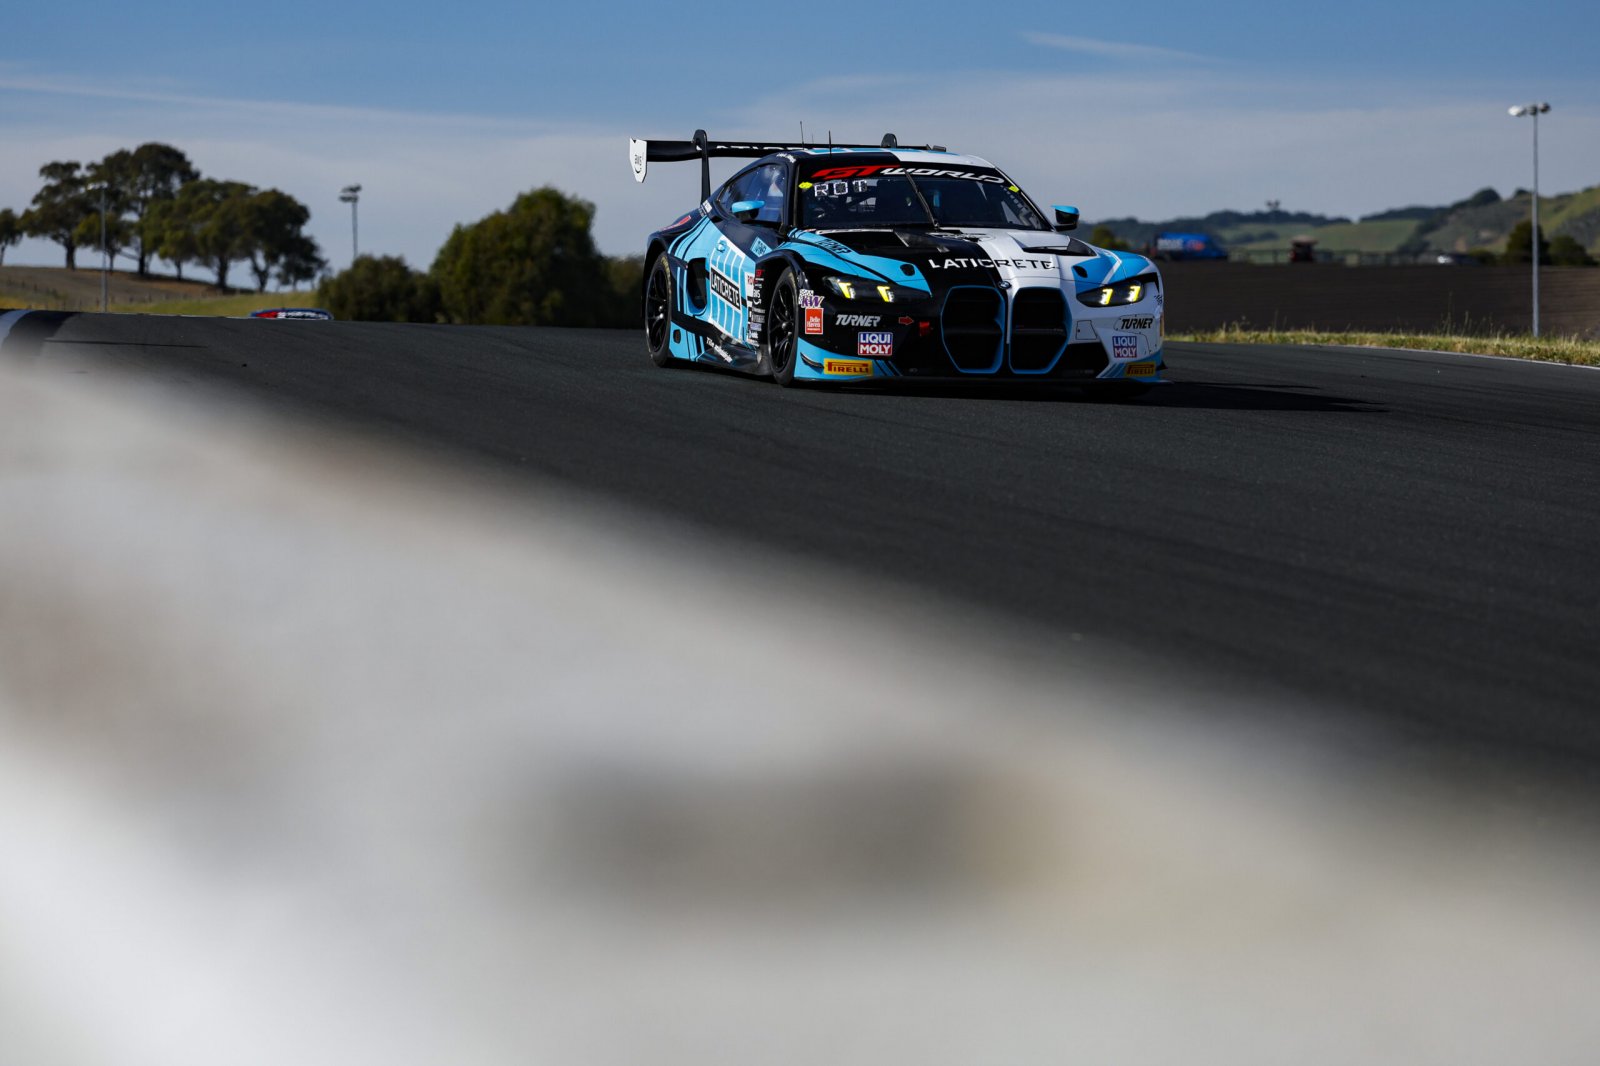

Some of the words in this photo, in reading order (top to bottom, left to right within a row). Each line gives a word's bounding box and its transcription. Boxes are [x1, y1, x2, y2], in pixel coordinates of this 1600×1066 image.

[928, 258, 1056, 270] LATICRETE
[711, 271, 740, 307] LATICRETE
[835, 314, 881, 327] TURNER
[1120, 318, 1153, 330] TURNER
[860, 334, 891, 344] LIQUI
[1113, 337, 1136, 347] LIQUI
[860, 345, 891, 354] MOLY
[1114, 347, 1137, 357] MOLY
[828, 361, 869, 373] PIRELLI
[1127, 363, 1155, 375] PIRELLI
